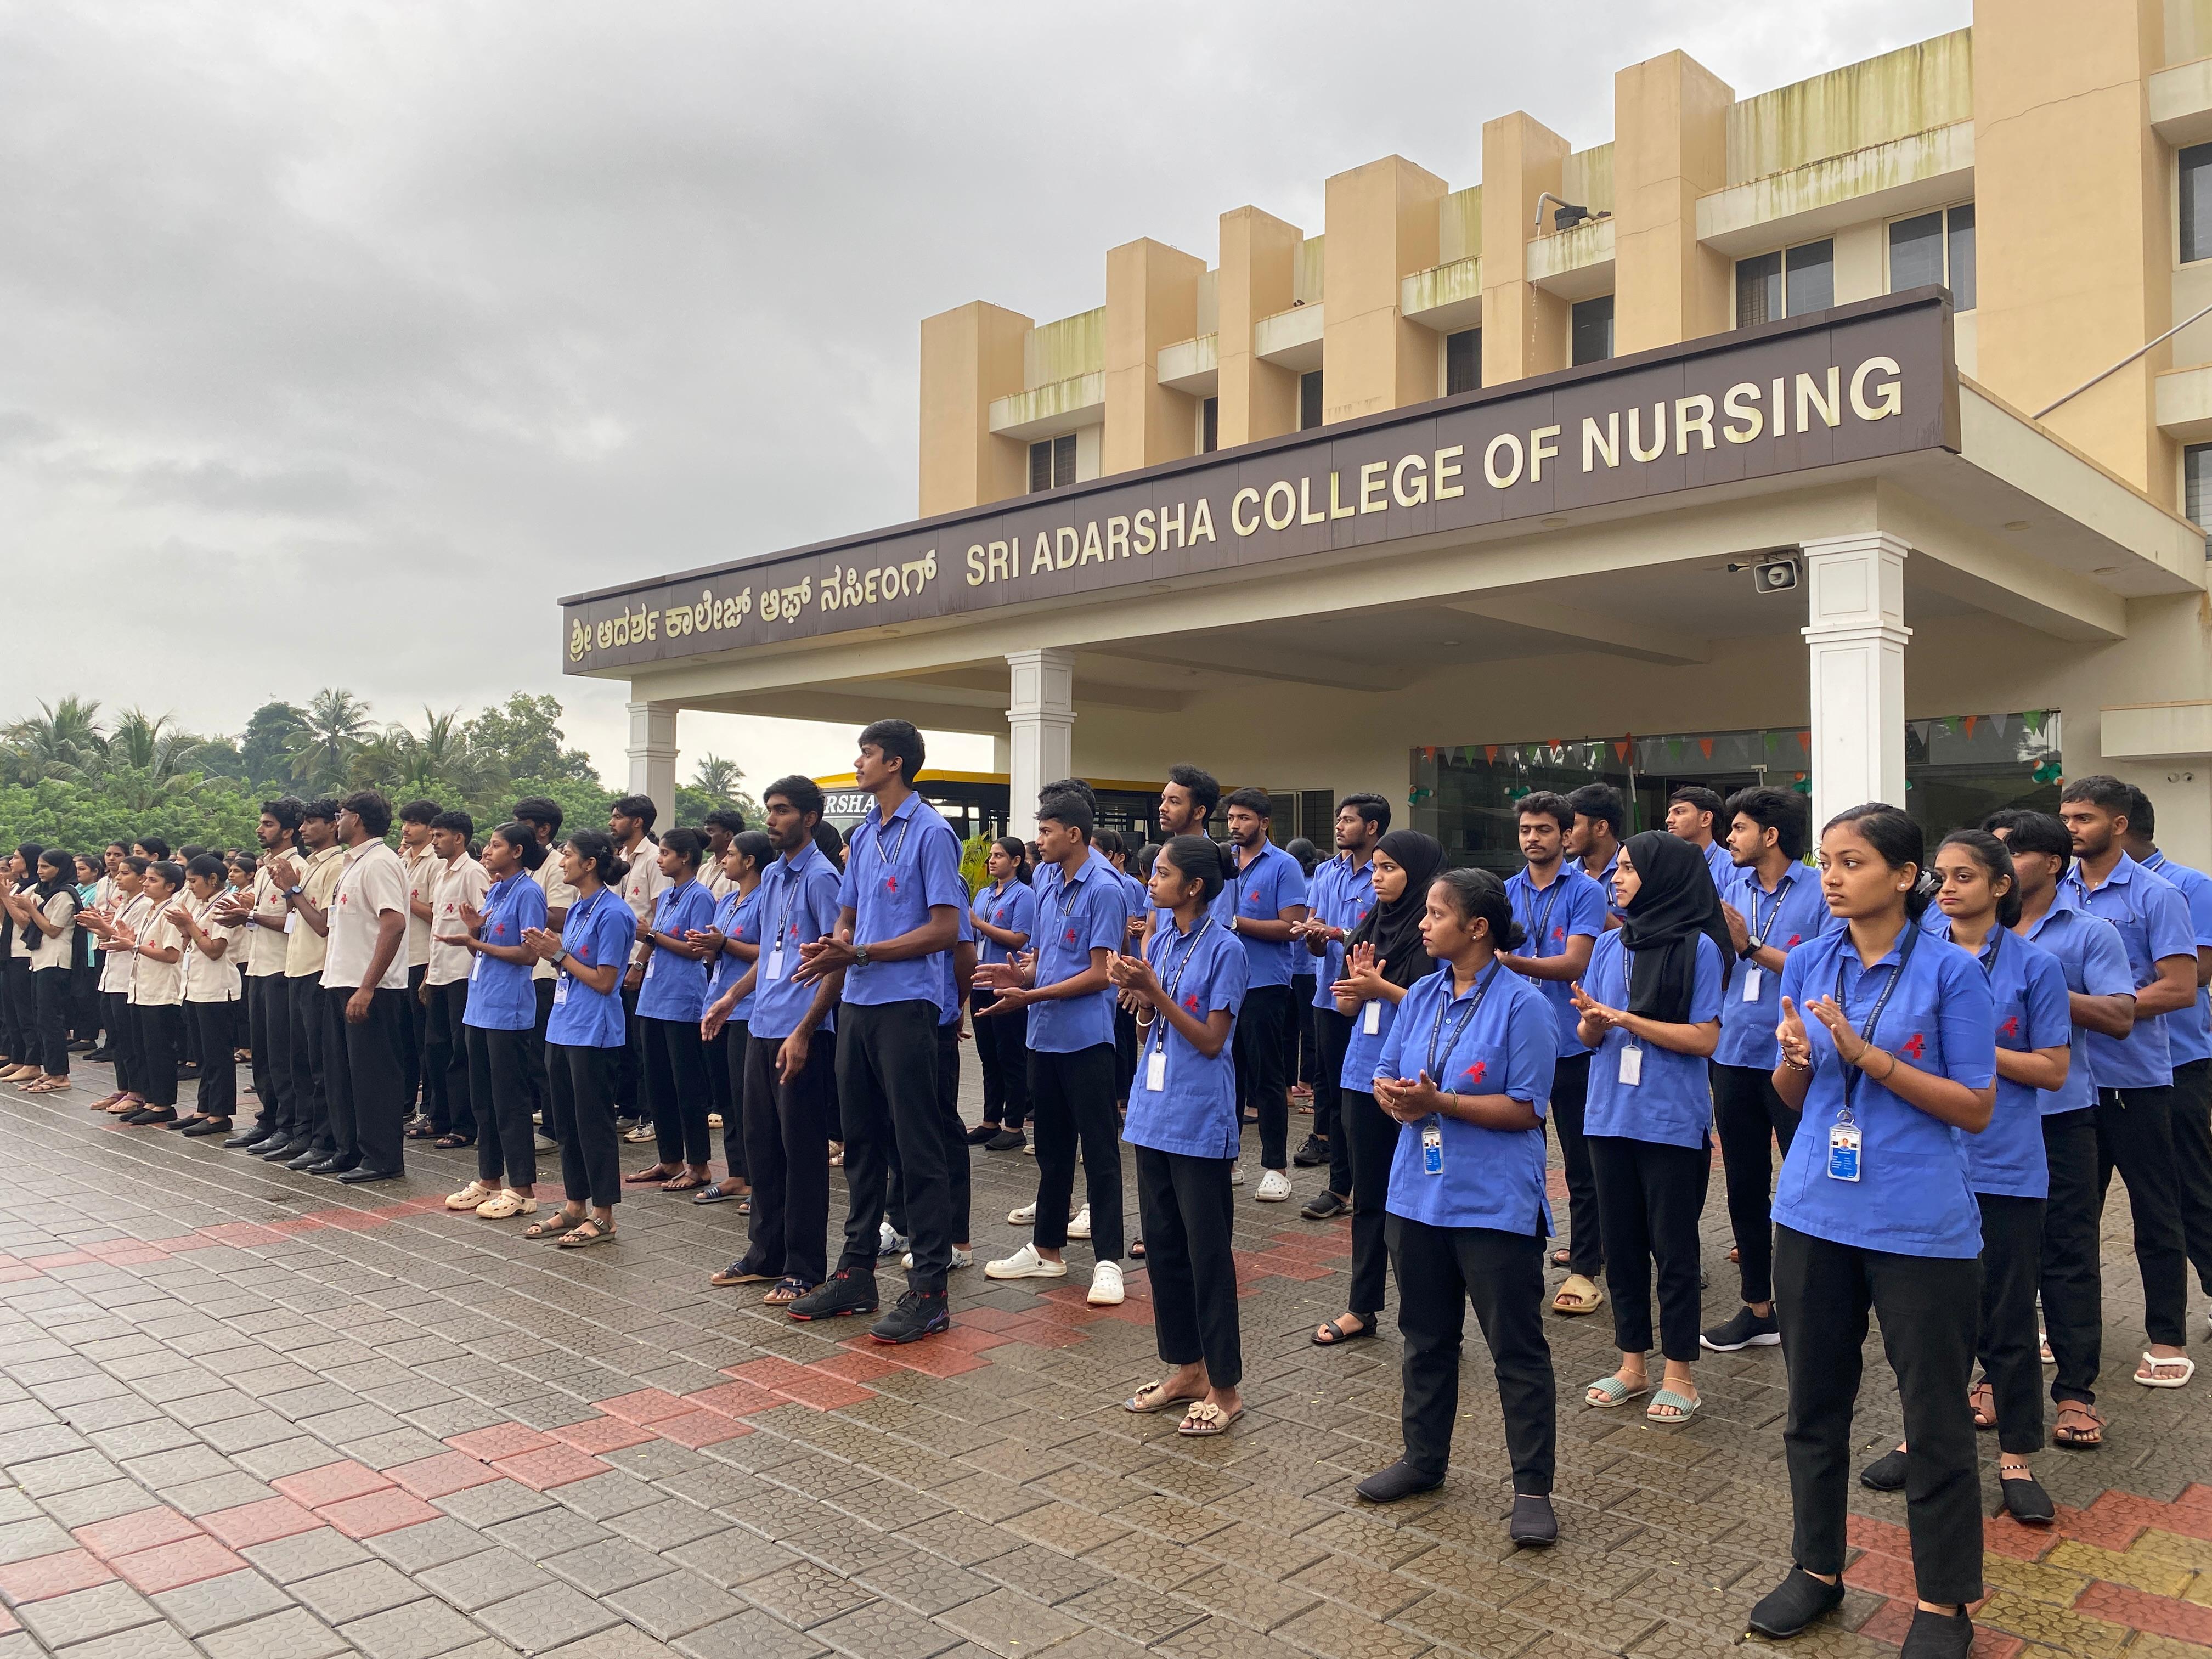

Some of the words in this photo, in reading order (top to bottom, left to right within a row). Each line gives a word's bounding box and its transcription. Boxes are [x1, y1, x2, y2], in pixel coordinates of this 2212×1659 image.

[966, 537, 1019, 586] SRI
[1030, 499, 1217, 575] ADARSHA
[1231, 445, 1465, 537] COLLEGE
[1483, 424, 1561, 489] OF
[1582, 356, 1902, 473] NURSING
[569, 618, 592, 662] ಶ್ರೀ
[597, 603, 660, 650] ಆದರ್ಶ
[665, 586, 752, 638] ಕಾಲೇಜ್
[760, 575, 812, 624] ಆಫ್
[820, 549, 937, 613] ನರ್ಸಿಂಗ್
[823, 794, 876, 814] RSHA
